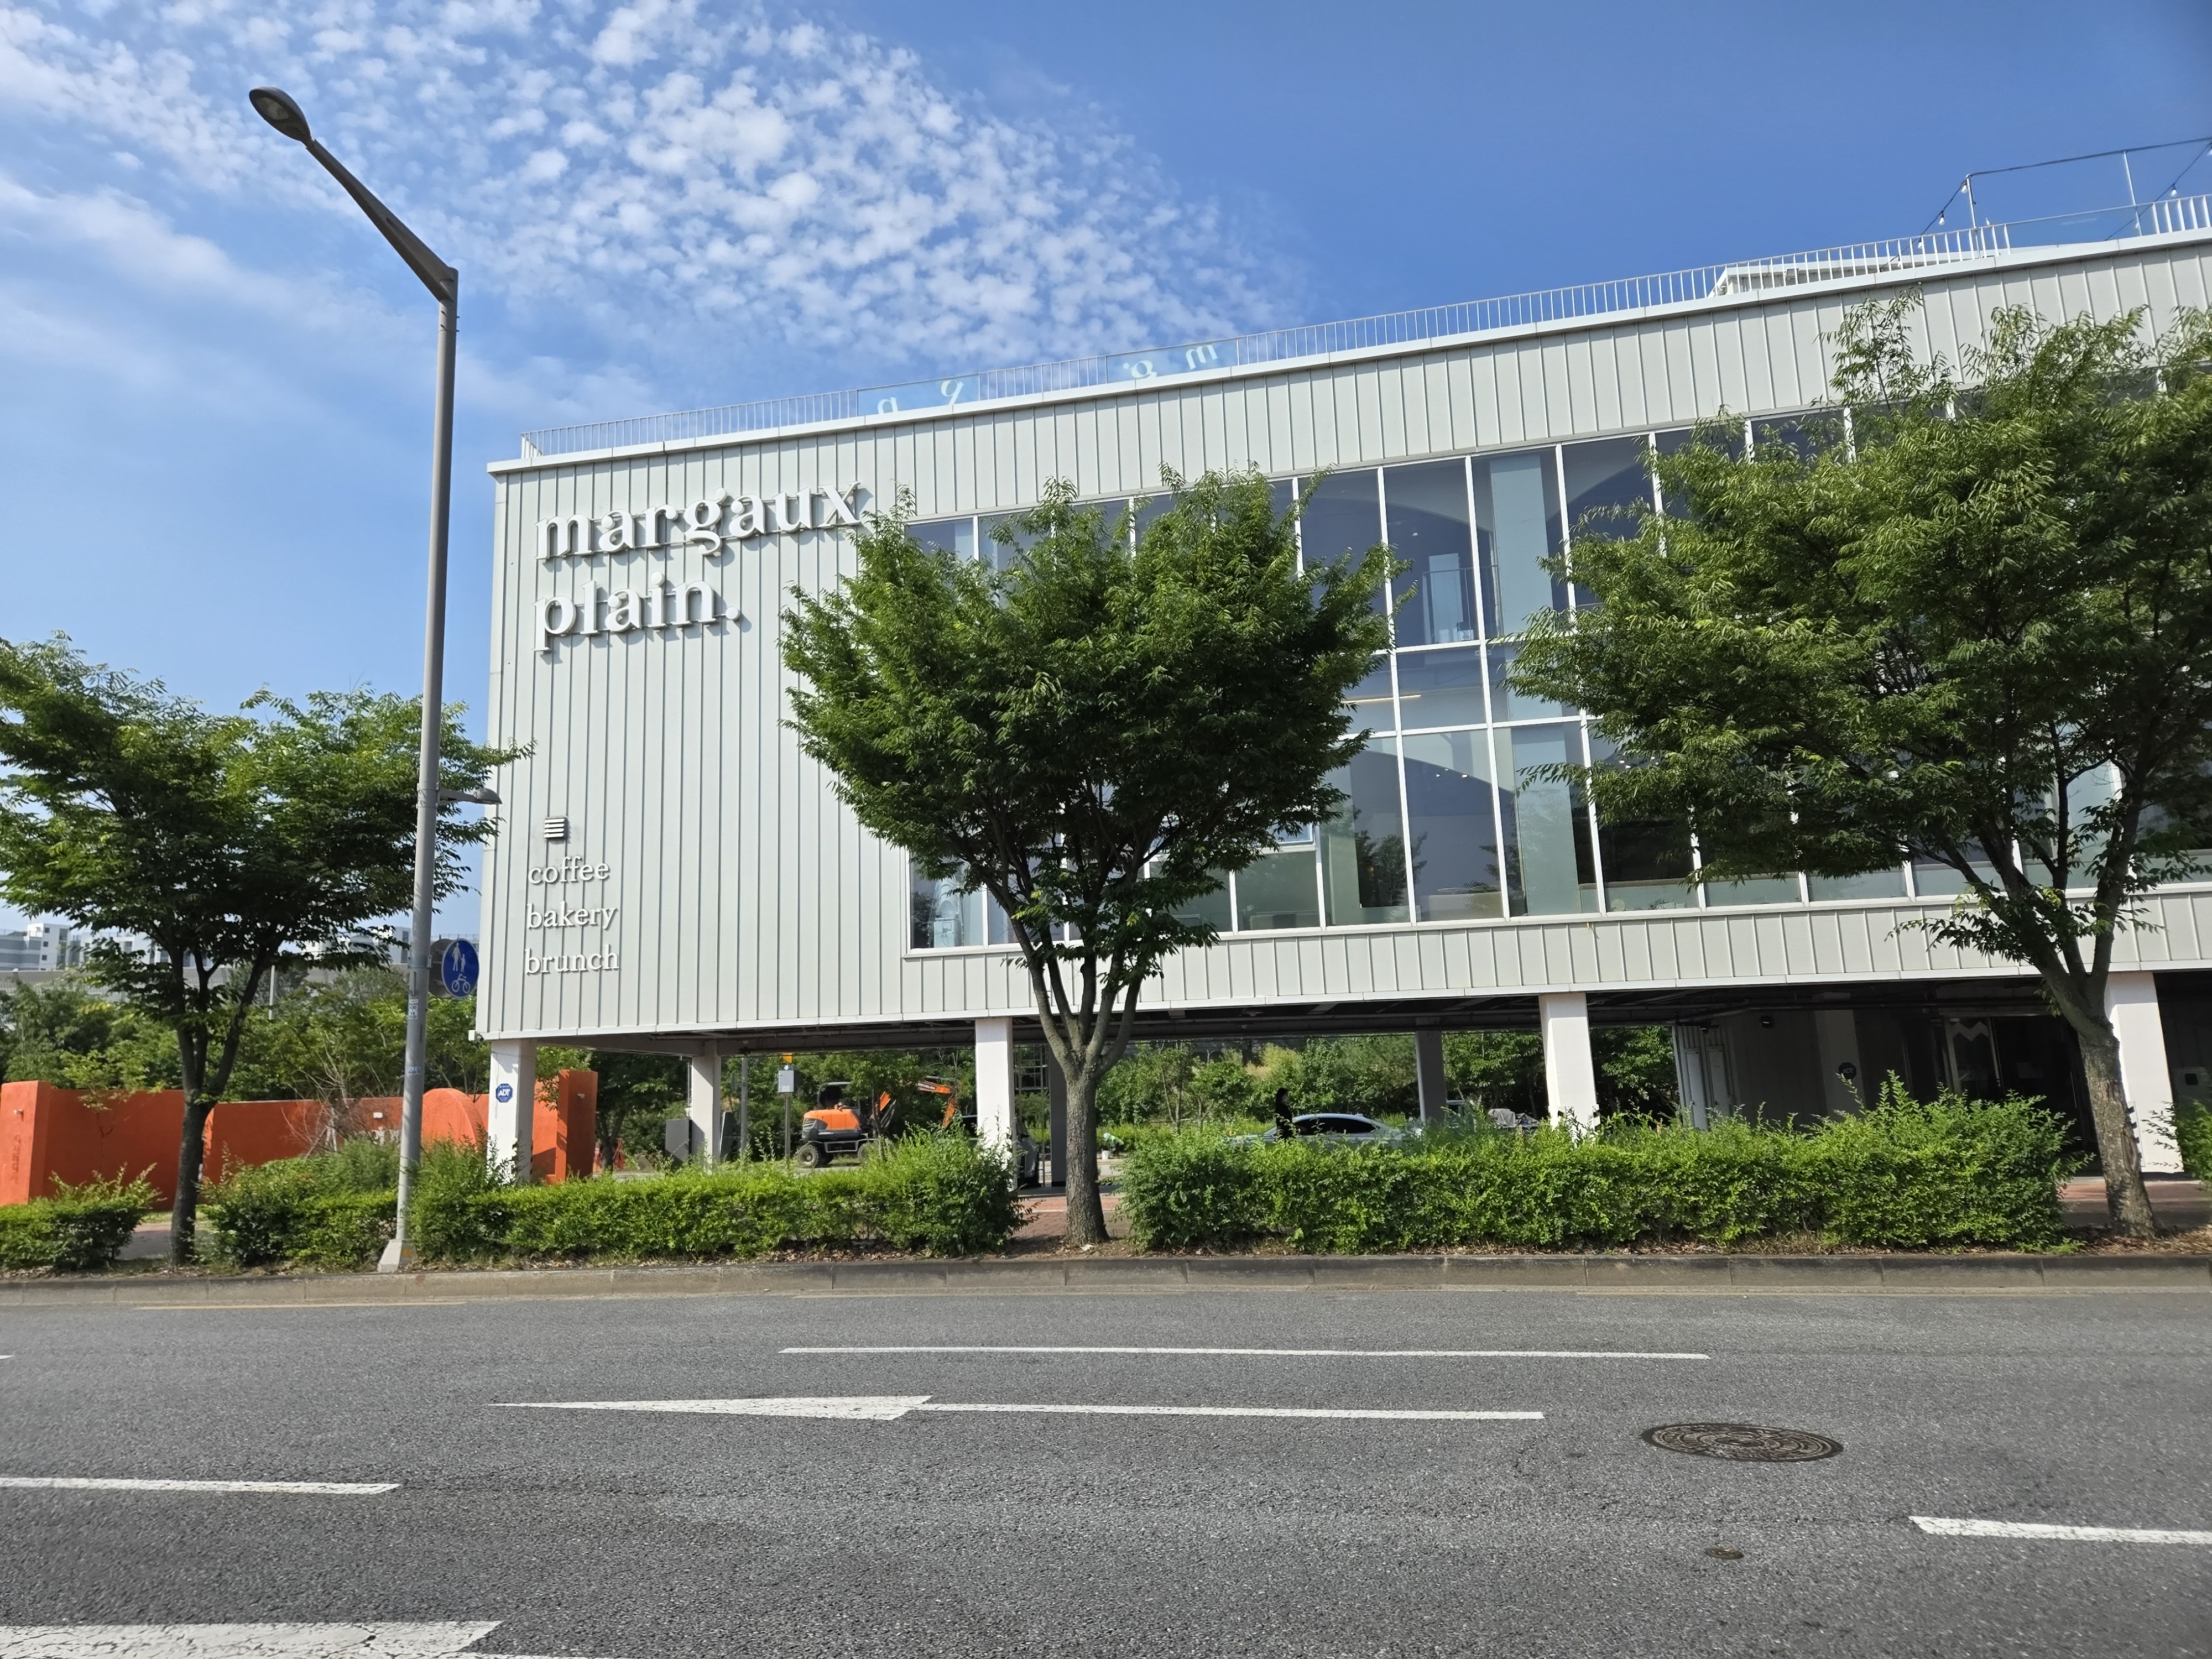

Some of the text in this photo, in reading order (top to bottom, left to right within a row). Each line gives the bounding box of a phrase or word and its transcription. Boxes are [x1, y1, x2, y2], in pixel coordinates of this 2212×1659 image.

[534, 481, 862, 560] margaux
[533, 571, 740, 653] plain.
[528, 855, 609, 885] coffee
[527, 901, 618, 930] bakery
[525, 943, 619, 974] brunch
